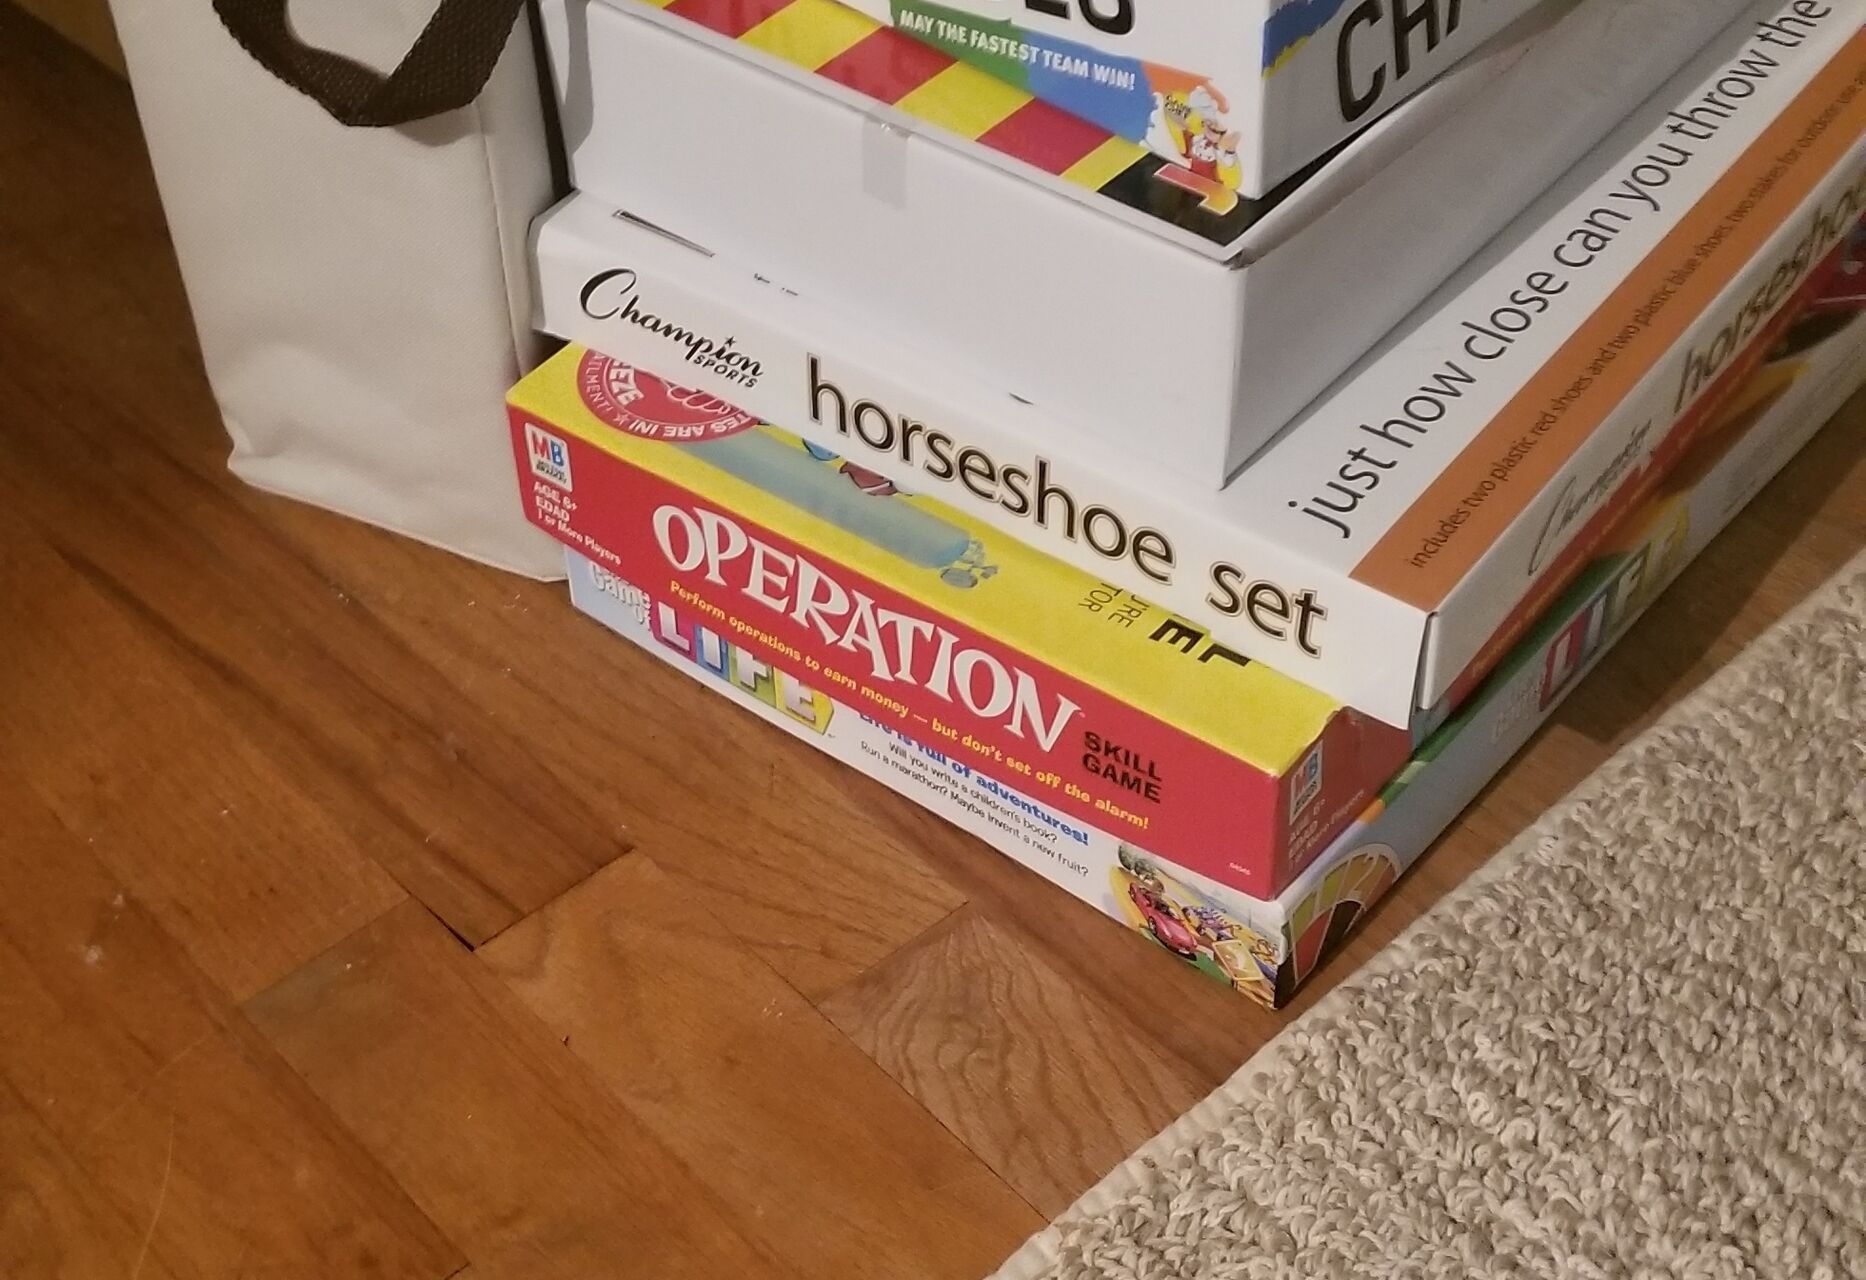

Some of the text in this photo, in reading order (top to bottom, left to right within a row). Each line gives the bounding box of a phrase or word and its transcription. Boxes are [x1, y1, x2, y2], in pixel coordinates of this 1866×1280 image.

[900, 9, 1136, 91] MAY THE FASTEST TEAM WIN!
[1287, 445, 1397, 539] just
[1359, 360, 1477, 449] how
[1461, 270, 1570, 362] close
[1553, 207, 1633, 268] can
[1608, 142, 1694, 212] you
[1667, 48, 1780, 142] throw
[1757, 0, 1832, 54] the
[579, 267, 764, 378] Champion
[693, 354, 759, 389] SPORTS
[1405, 507, 1472, 569] includes
[1461, 479, 1497, 509] two
[1490, 436, 1538, 482] plastic
[1531, 410, 1557, 436] red
[1552, 375, 1594, 414] shoes
[1592, 346, 1617, 377] and
[1613, 323, 1640, 351] two
[1634, 282, 1677, 327] plastic
[1669, 257, 1701, 286] blue
[531, 430, 565, 467] MB
[629, 417, 659, 436] IN!
[662, 424, 704, 438] ARE
[533, 481, 561, 504] AGE
[535, 495, 570, 522] EDAD
[806, 351, 1177, 586] horseshoe
[1205, 559, 1328, 658] set
[544, 514, 556, 526] or
[557, 520, 584, 543] More
[584, 535, 622, 566] Players
[651, 504, 1084, 754] OPERATION
[657, 600, 818, 723] LIFE
[669, 579, 726, 622] Perform
[728, 614, 802, 663] operations
[804, 654, 821, 673] to
[823, 665, 858, 691] earn
[860, 681, 910, 719] money
[931, 717, 959, 742] but
[961, 733, 1003, 763] don't
[1005, 755, 1033, 777] set
[1035, 770, 1062, 790] off
[1064, 782, 1091, 804] the
[1094, 795, 1150, 830] alarm!
[888, 740, 908, 758] Will
[909, 753, 930, 773] you
[930, 764, 960, 791] write
[969, 786, 1022, 825] children's
[1023, 815, 1058, 844] book?
[1081, 754, 1163, 806] GAME
[1082, 730, 1165, 782] SKILL
[860, 740, 882, 760] Run
[890, 759, 950, 797] marathon?
[950, 790, 986, 819] Maybe
[987, 811, 1021, 841] invent
[1031, 839, 1056, 860] new
[1056, 852, 1090, 878] fruit?
[951, 761, 973, 778] of
[976, 773, 1090, 847] adventures!
